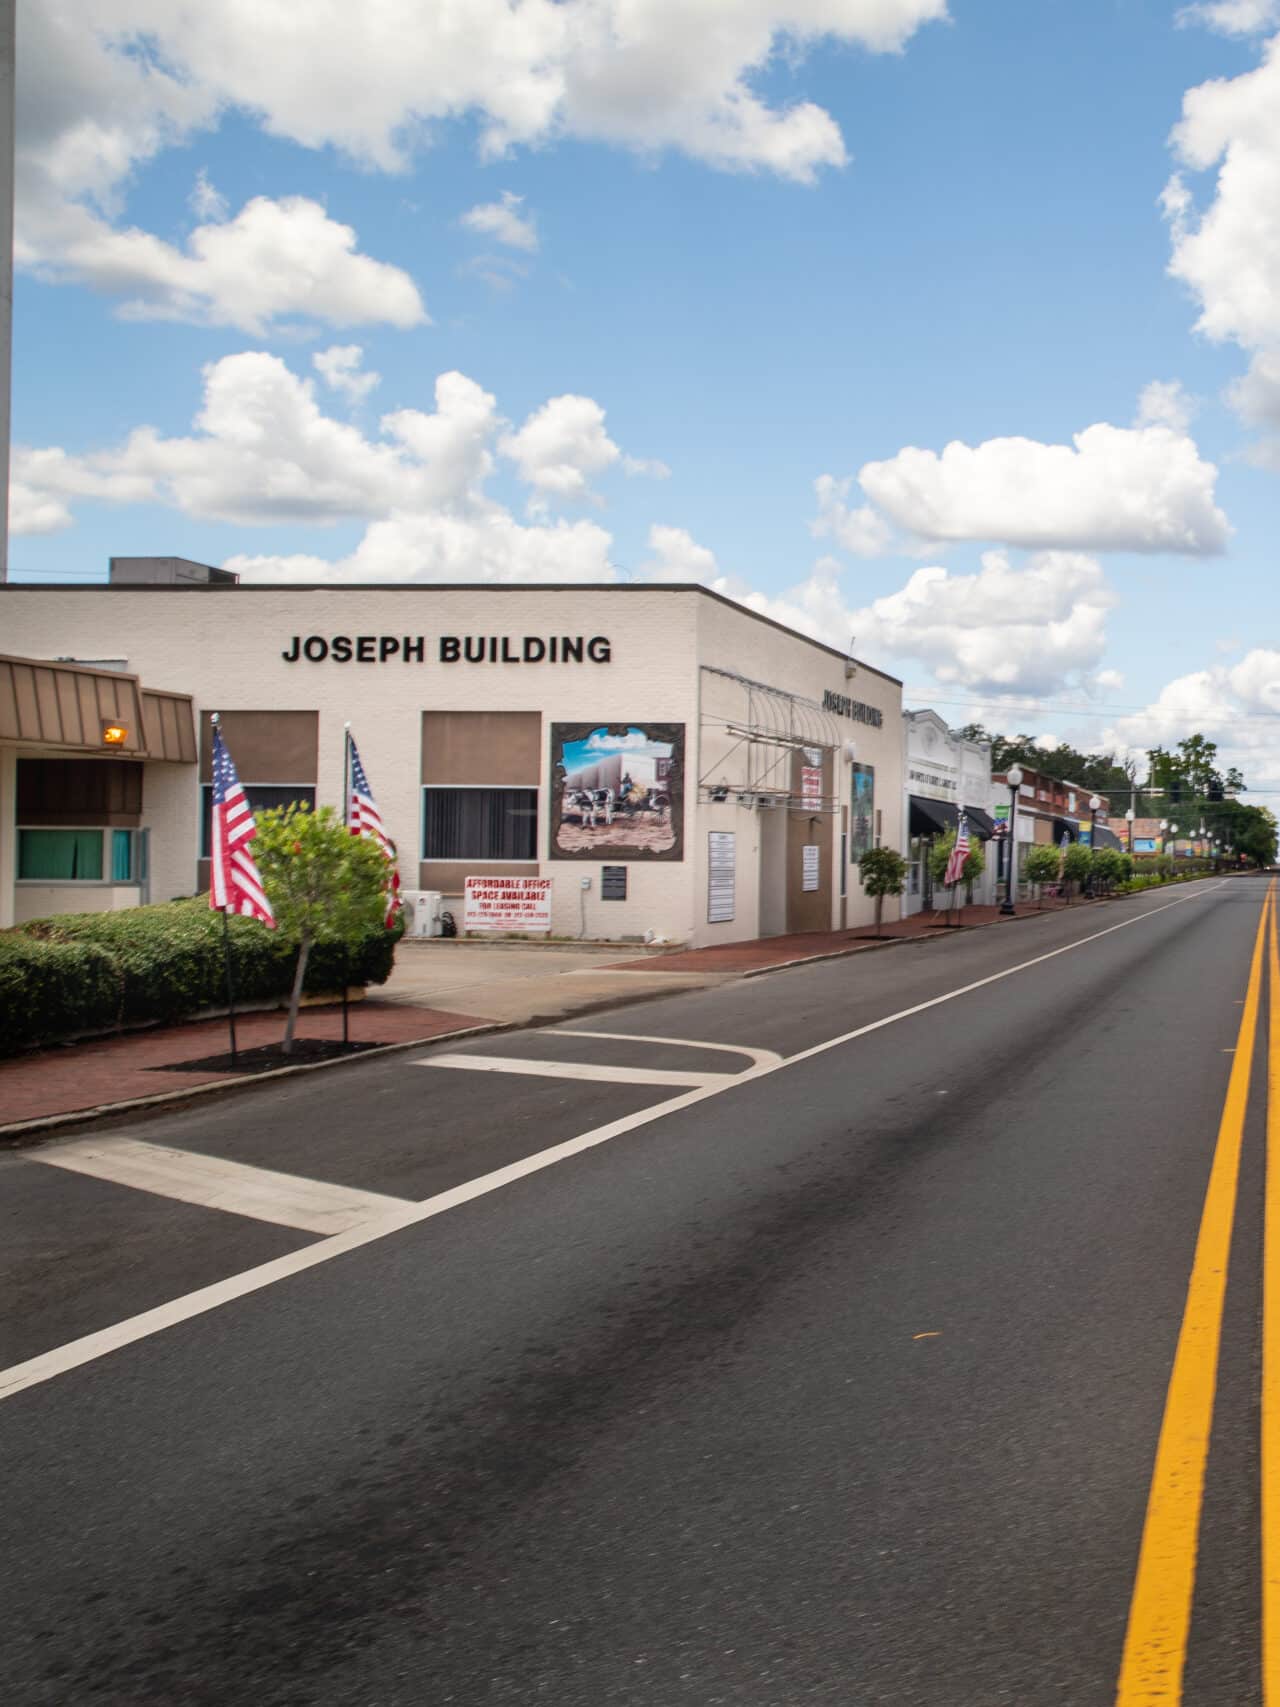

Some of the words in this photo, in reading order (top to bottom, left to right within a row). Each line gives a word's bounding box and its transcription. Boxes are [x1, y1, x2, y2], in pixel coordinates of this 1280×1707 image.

[282, 636, 424, 663] JOSEPH
[439, 636, 612, 663] BUILDING
[822, 689, 851, 718] JOSEPH
[852, 700, 882, 729] BUILDING
[467, 879, 521, 889] AFFORDABLE
[523, 879, 551, 889] OFFICE
[472, 890, 499, 900] SPACE
[501, 890, 546, 901] AVAILABLE
[480, 902, 492, 910] FOR
[494, 902, 520, 911] LEASING
[522, 903, 537, 911] CALL
